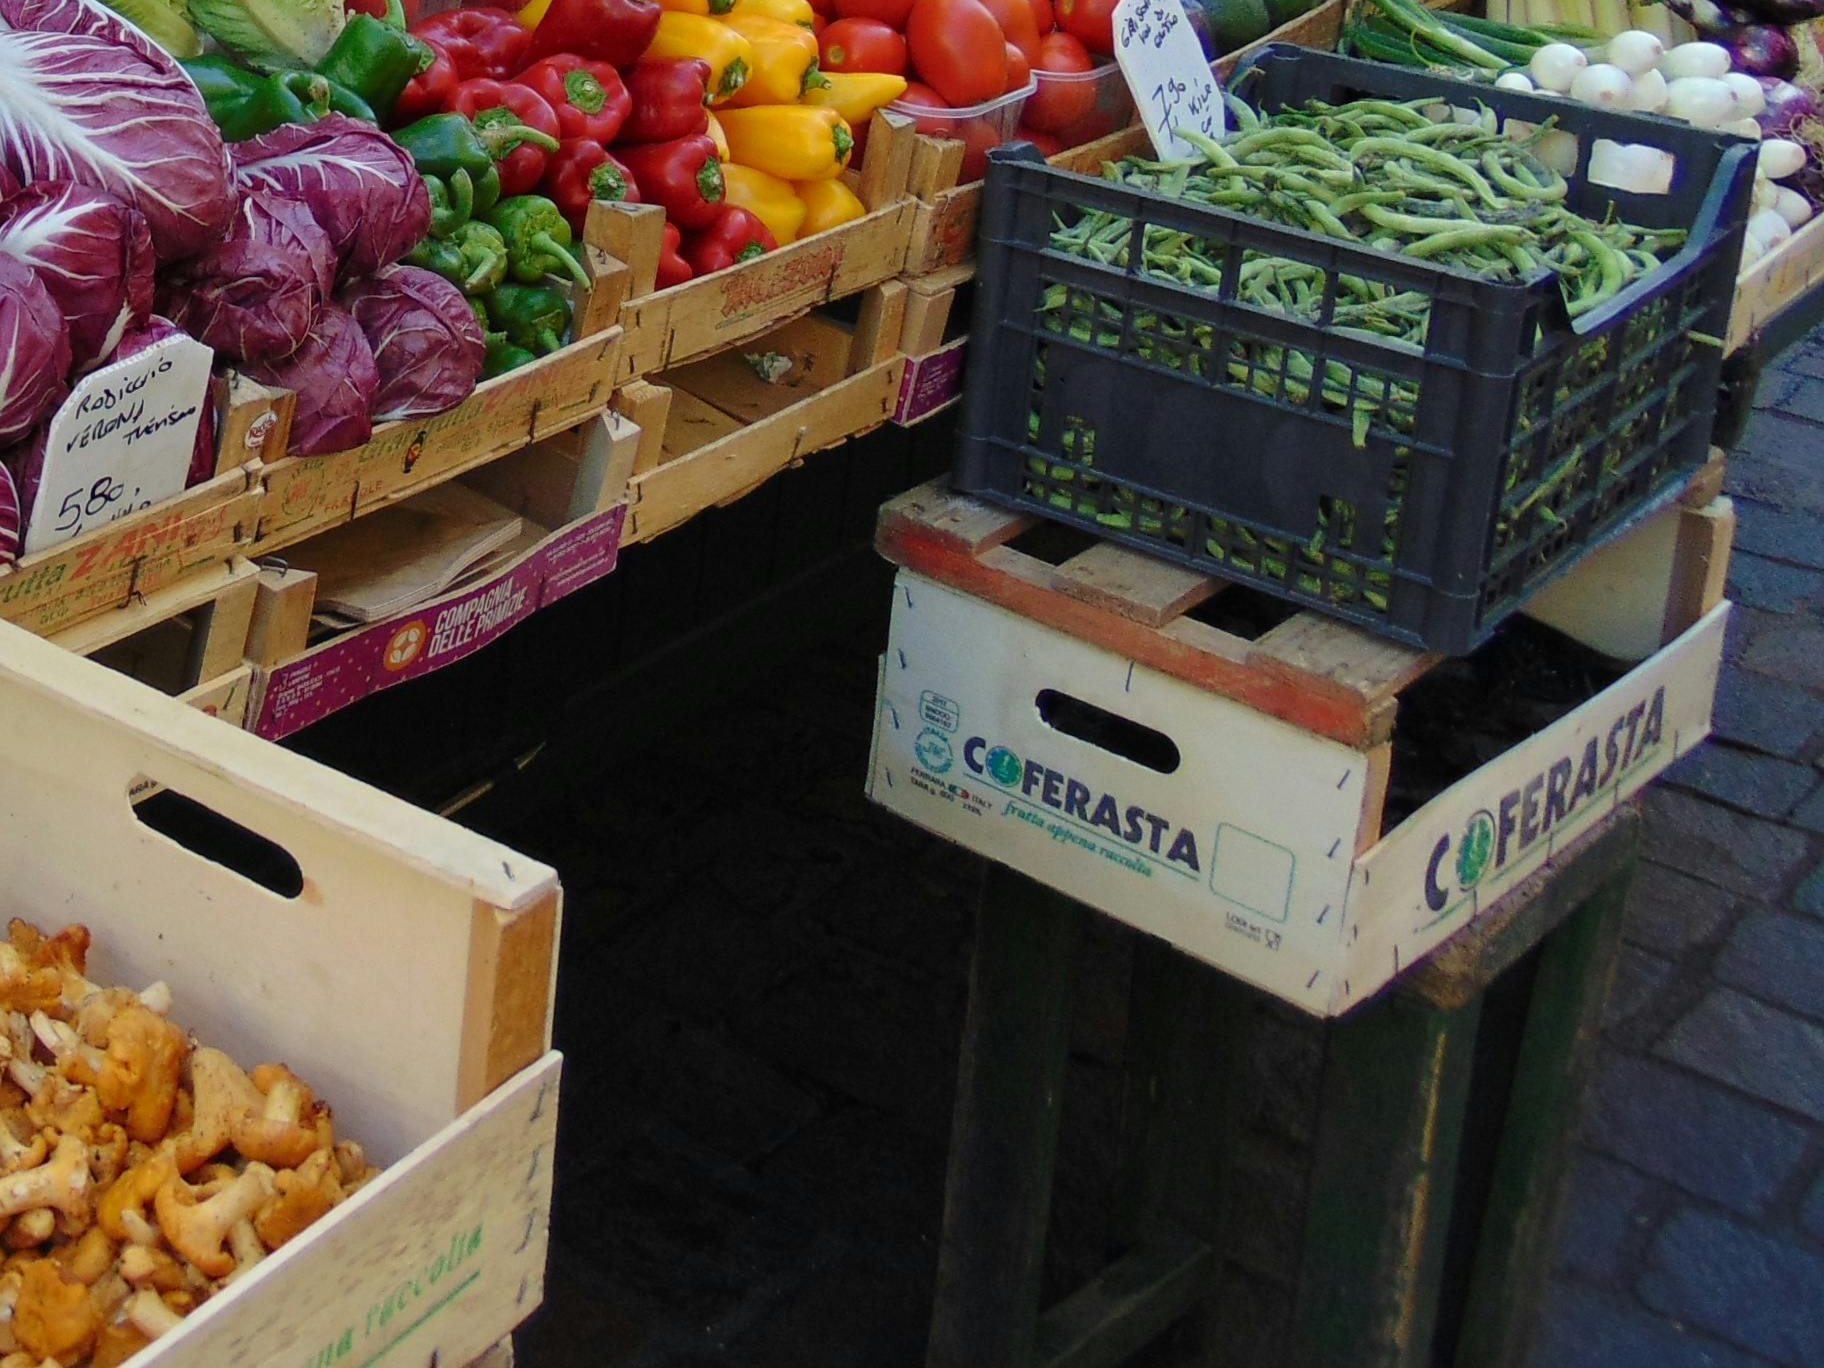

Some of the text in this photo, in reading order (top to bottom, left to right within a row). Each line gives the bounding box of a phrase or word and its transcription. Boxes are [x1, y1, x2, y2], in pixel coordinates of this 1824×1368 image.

[427, 585, 528, 659] DELLE PRIMIZIE
[434, 575, 515, 633] COMPAGNIA
[963, 735, 1201, 873] COFERASTA
[1001, 799, 1045, 829] frutta
[1424, 684, 1666, 912] COFERASTA
